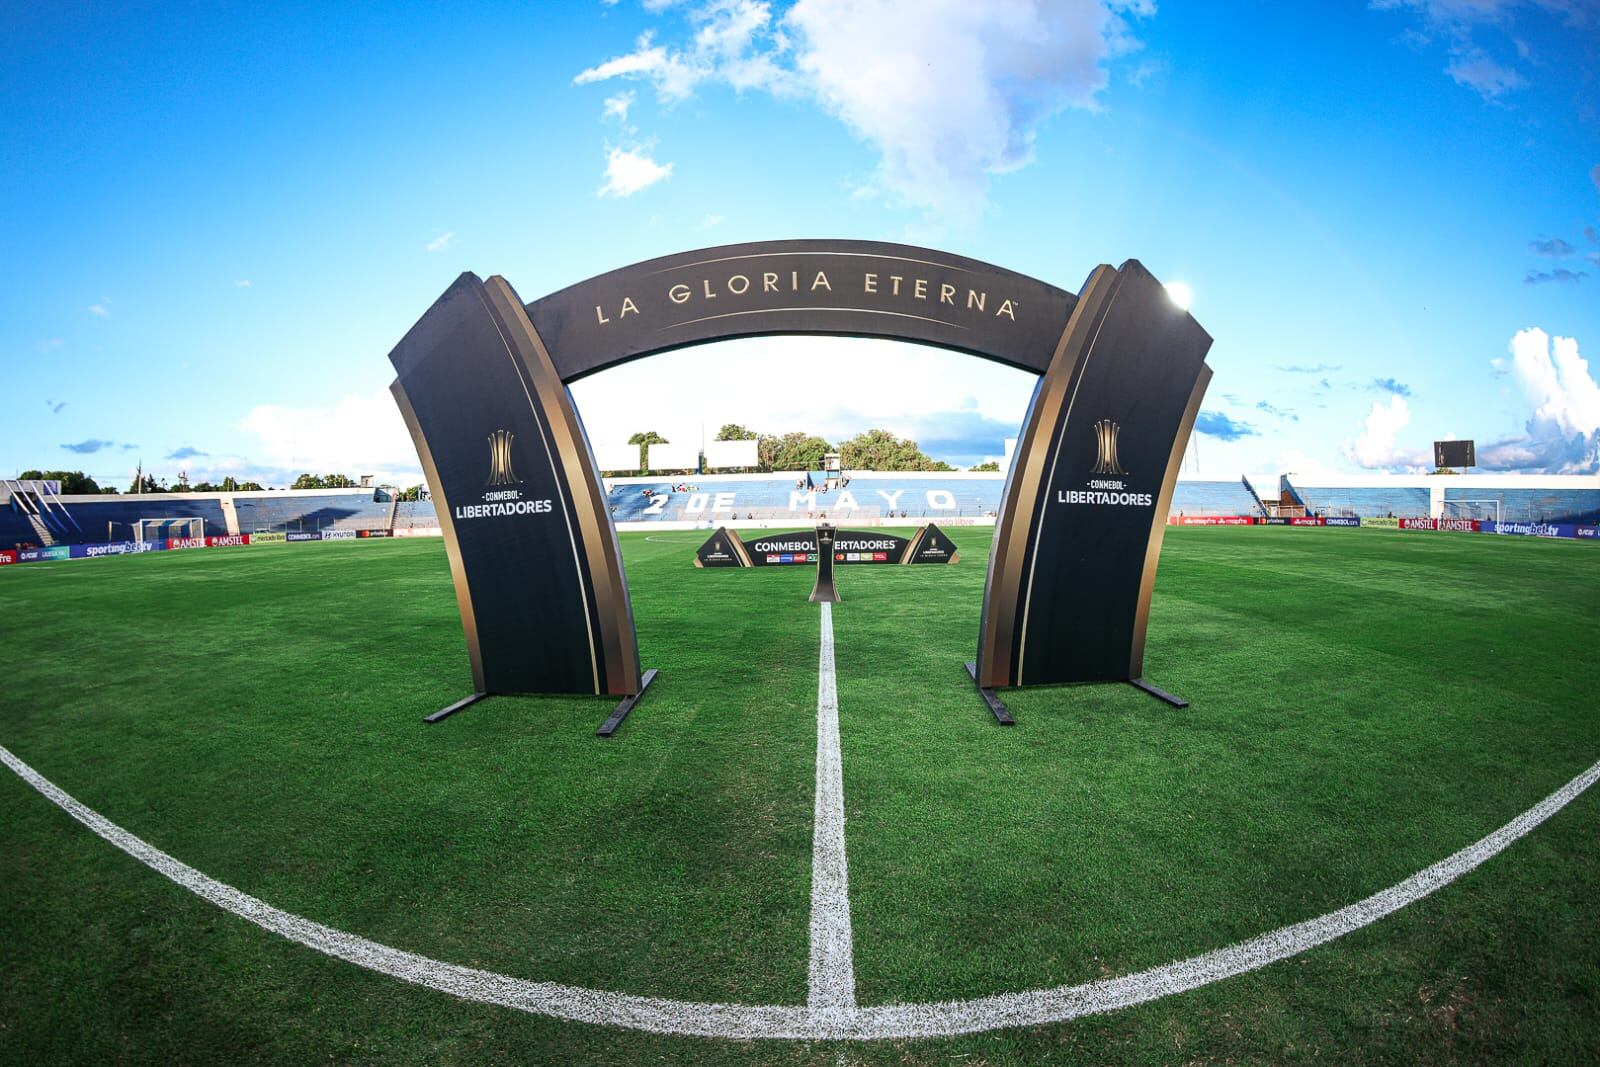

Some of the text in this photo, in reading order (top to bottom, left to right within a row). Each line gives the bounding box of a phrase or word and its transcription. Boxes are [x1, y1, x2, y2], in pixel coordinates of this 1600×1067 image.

[596, 297, 640, 325] LA
[668, 271, 832, 304] GLORIA
[1090, 479, 1125, 490] CONMEBOL
[485, 490, 520, 502] CONMEBOL
[642, 489, 958, 515] 2 DE MAYO
[1058, 490, 1153, 506] LIBERTADORES
[456, 499, 553, 519] LIBERTADORES
[1410, 519, 1434, 530] AMSTEL
[1447, 520, 1473, 531] AMSTEL
[216, 536, 243, 547] AMSTEL
[754, 540, 896, 552] CONMEBOL ERTADORES
